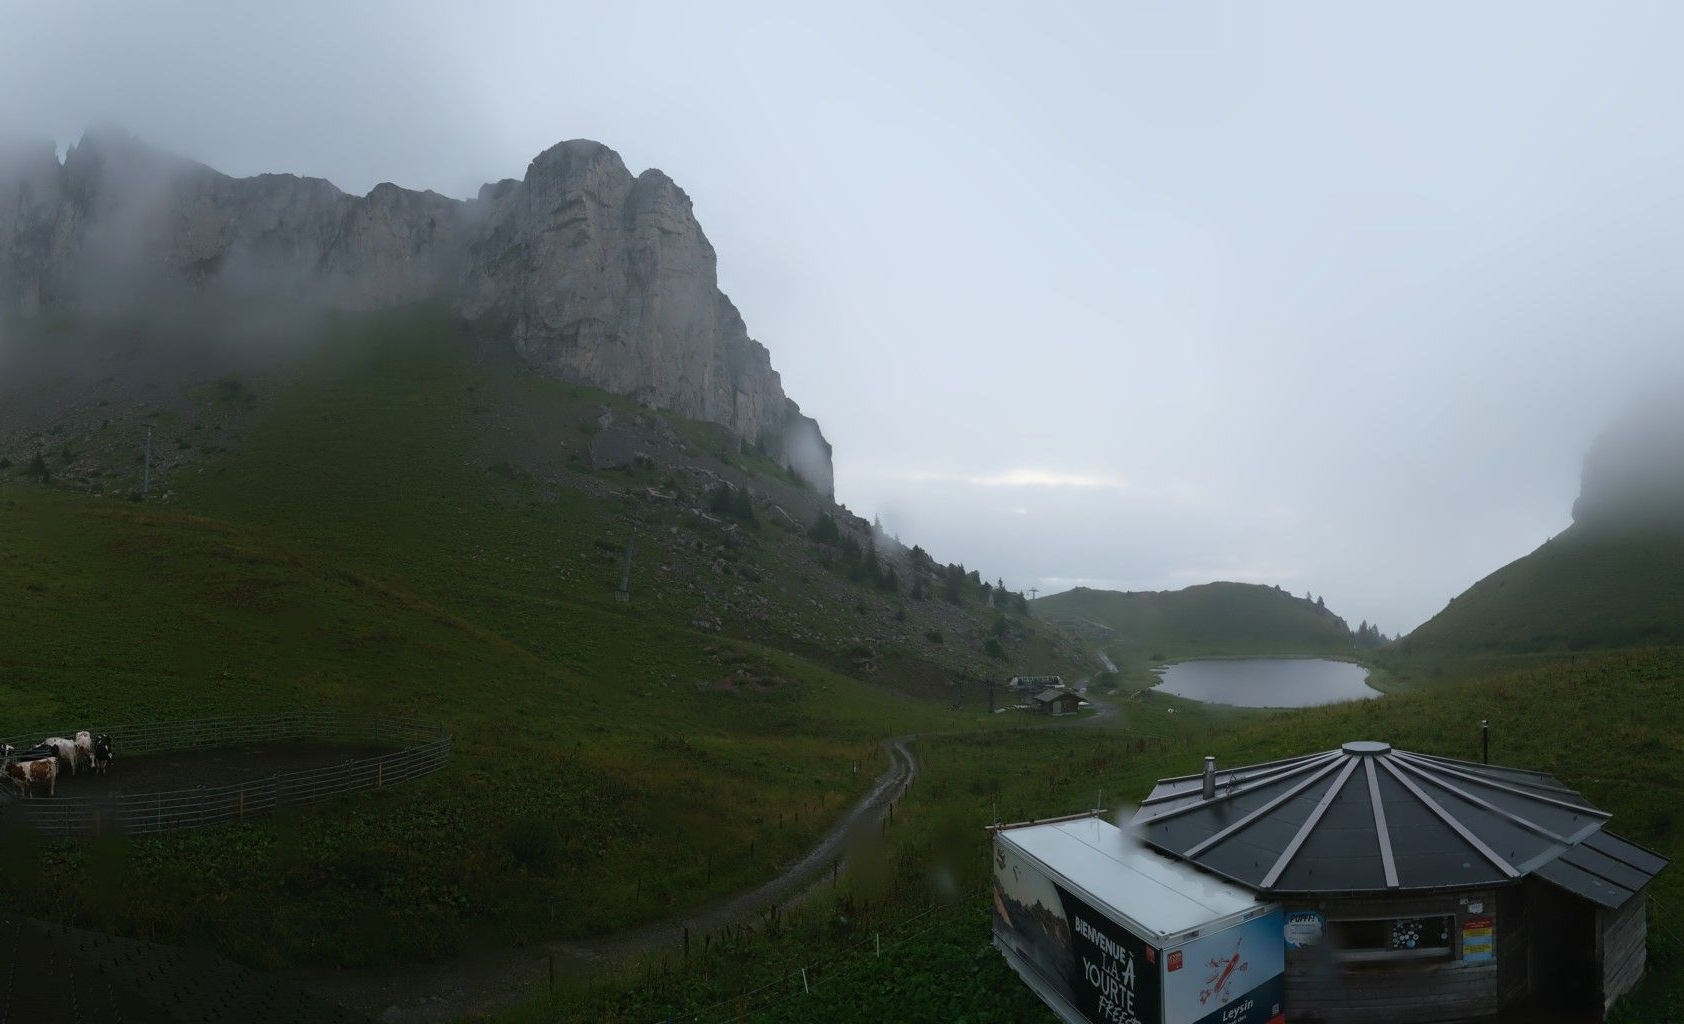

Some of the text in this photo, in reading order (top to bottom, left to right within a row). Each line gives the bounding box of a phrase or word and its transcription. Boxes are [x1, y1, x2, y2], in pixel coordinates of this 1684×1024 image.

[1076, 916, 1127, 965] BIENVENUE
[1083, 956, 1134, 1016] YOURTE
[1102, 952, 1121, 981] LA
[1222, 999, 1254, 1021] Leysin
